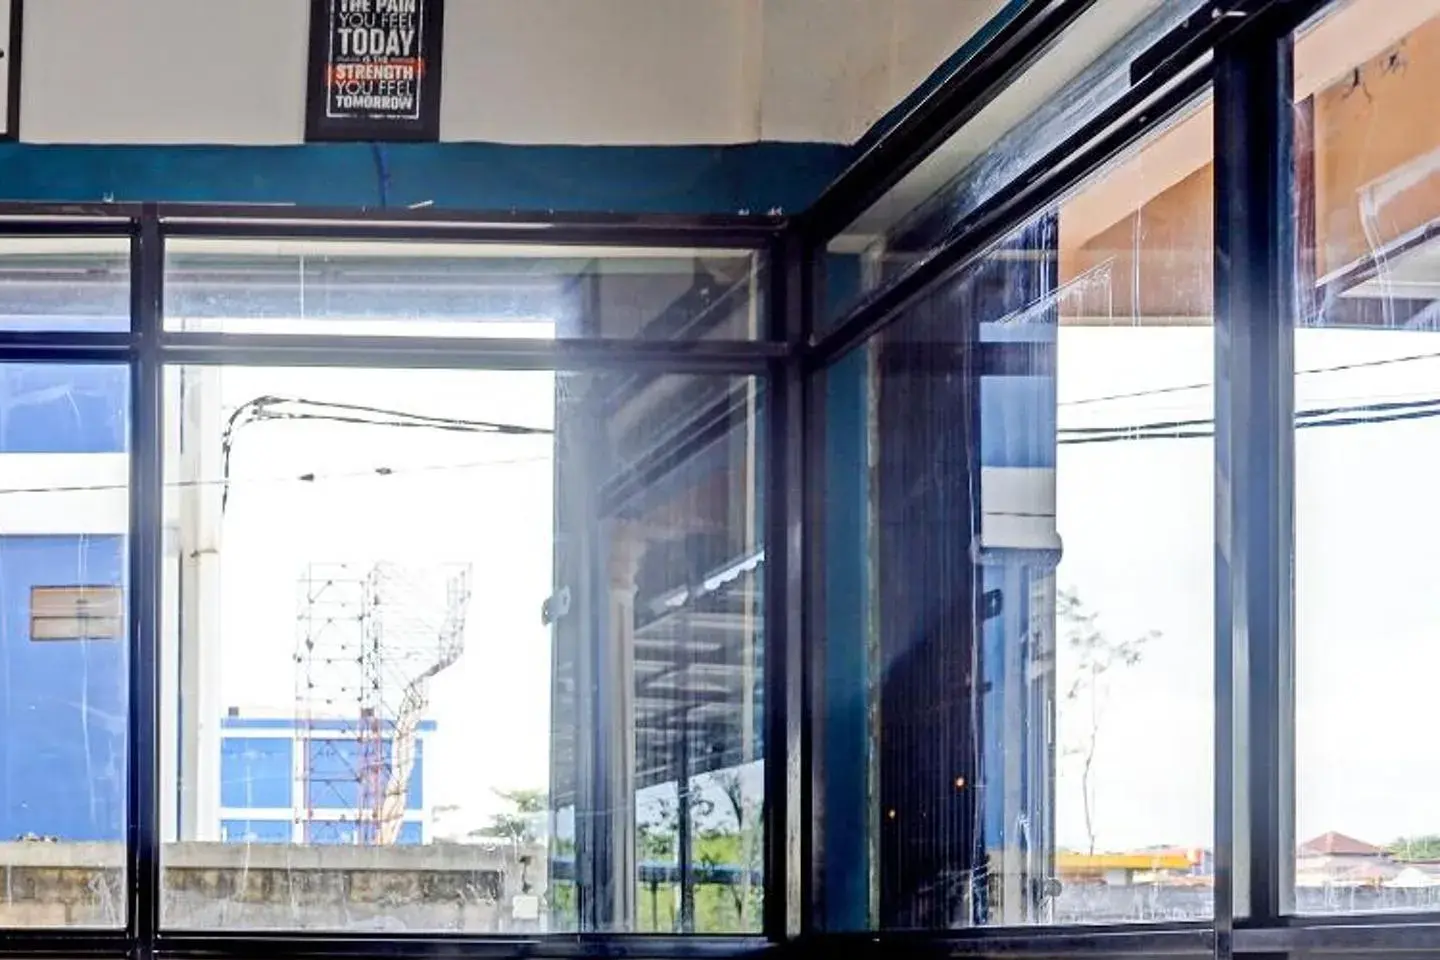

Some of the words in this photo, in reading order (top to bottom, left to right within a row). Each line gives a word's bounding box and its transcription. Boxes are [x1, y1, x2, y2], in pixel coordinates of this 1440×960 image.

[341, 0, 371, 12] THE
[376, 0, 416, 13] PAIN
[340, 13, 376, 28] YOU
[381, 13, 414, 28] FEEL
[337, 28, 415, 56] TODAY
[335, 64, 414, 80] STRENGTH
[336, 80, 373, 96] YOU
[379, 80, 412, 96] FEEL
[335, 95, 413, 110] TOMORROW
